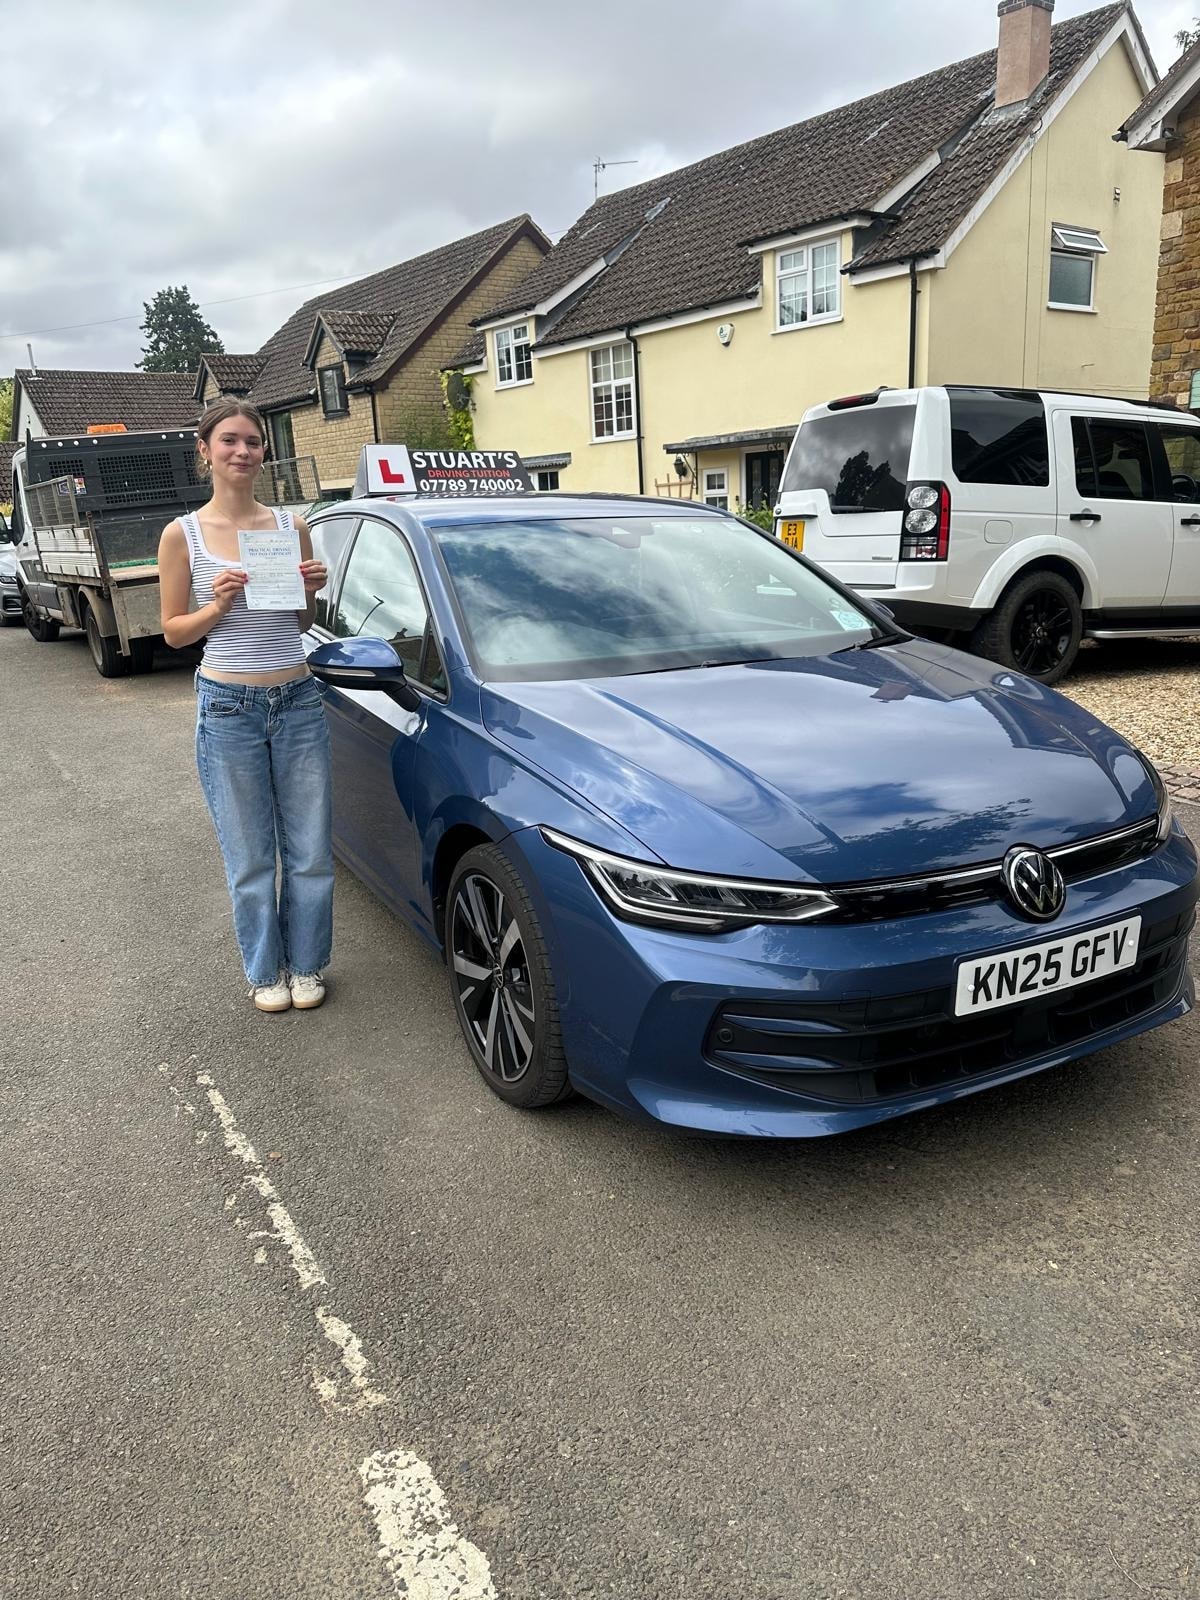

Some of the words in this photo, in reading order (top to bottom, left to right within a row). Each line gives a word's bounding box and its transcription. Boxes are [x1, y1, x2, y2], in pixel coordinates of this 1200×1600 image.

[412, 451, 518, 469] STUART'S
[378, 459, 405, 484] L
[427, 469, 470, 478] DRIVING
[471, 469, 511, 478] TUITION
[420, 478, 467, 492] 07789
[468, 478, 525, 491] 740002
[787, 523, 798, 536] E3
[971, 945, 1064, 1005] KN25
[1070, 926, 1129, 979] GFV
